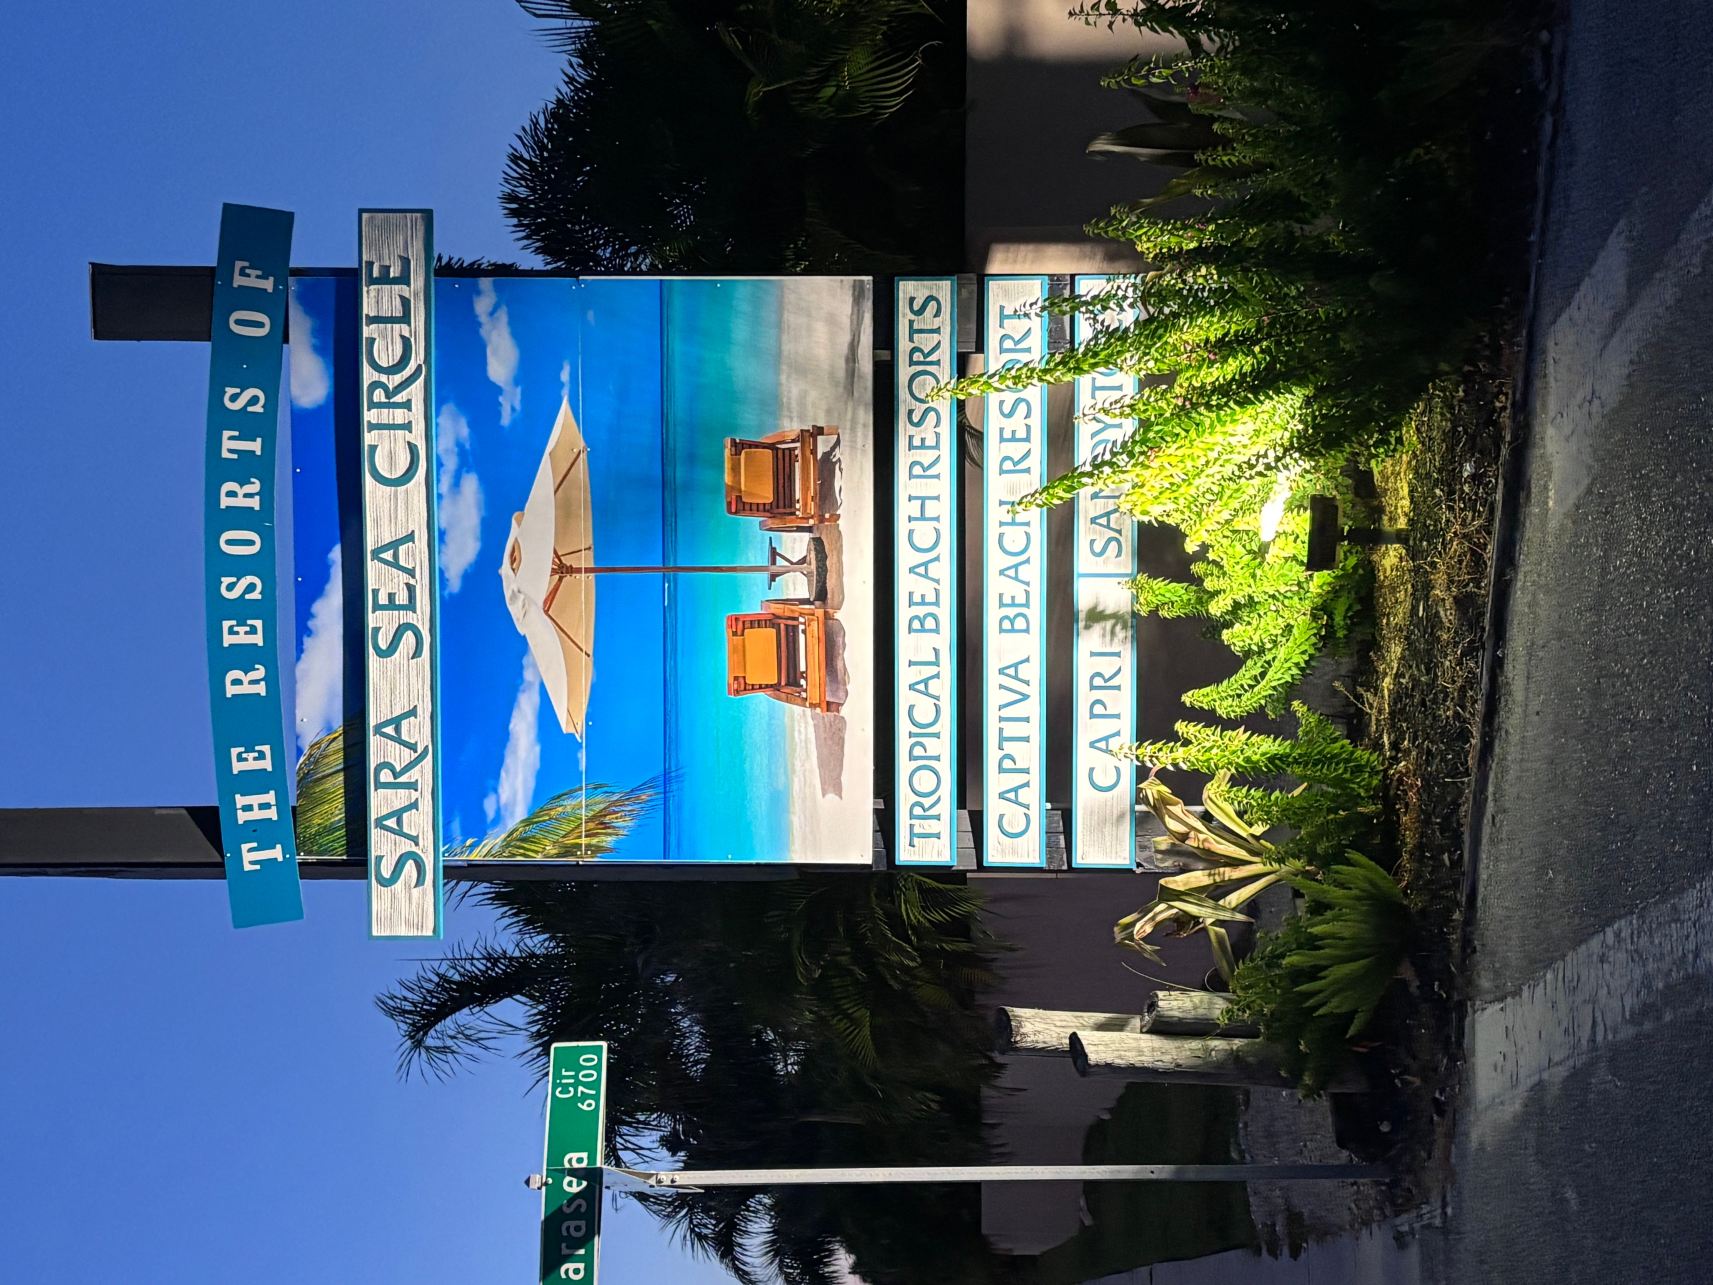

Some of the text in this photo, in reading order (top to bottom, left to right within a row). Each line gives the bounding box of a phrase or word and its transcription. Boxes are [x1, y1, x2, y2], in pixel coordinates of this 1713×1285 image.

[219, 260, 283, 872] THE RESORTS OF
[364, 253, 429, 889] SARA SEA CIRCLE
[908, 294, 943, 847] TROPICAL BEACH RESORTS
[998, 499, 1031, 635] BEACH
[998, 655, 1031, 839] CAPTIVA
[1088, 650, 1122, 793] CAPRI
[555, 1068, 576, 1099] Cir
[578, 1053, 599, 1112] 6700
